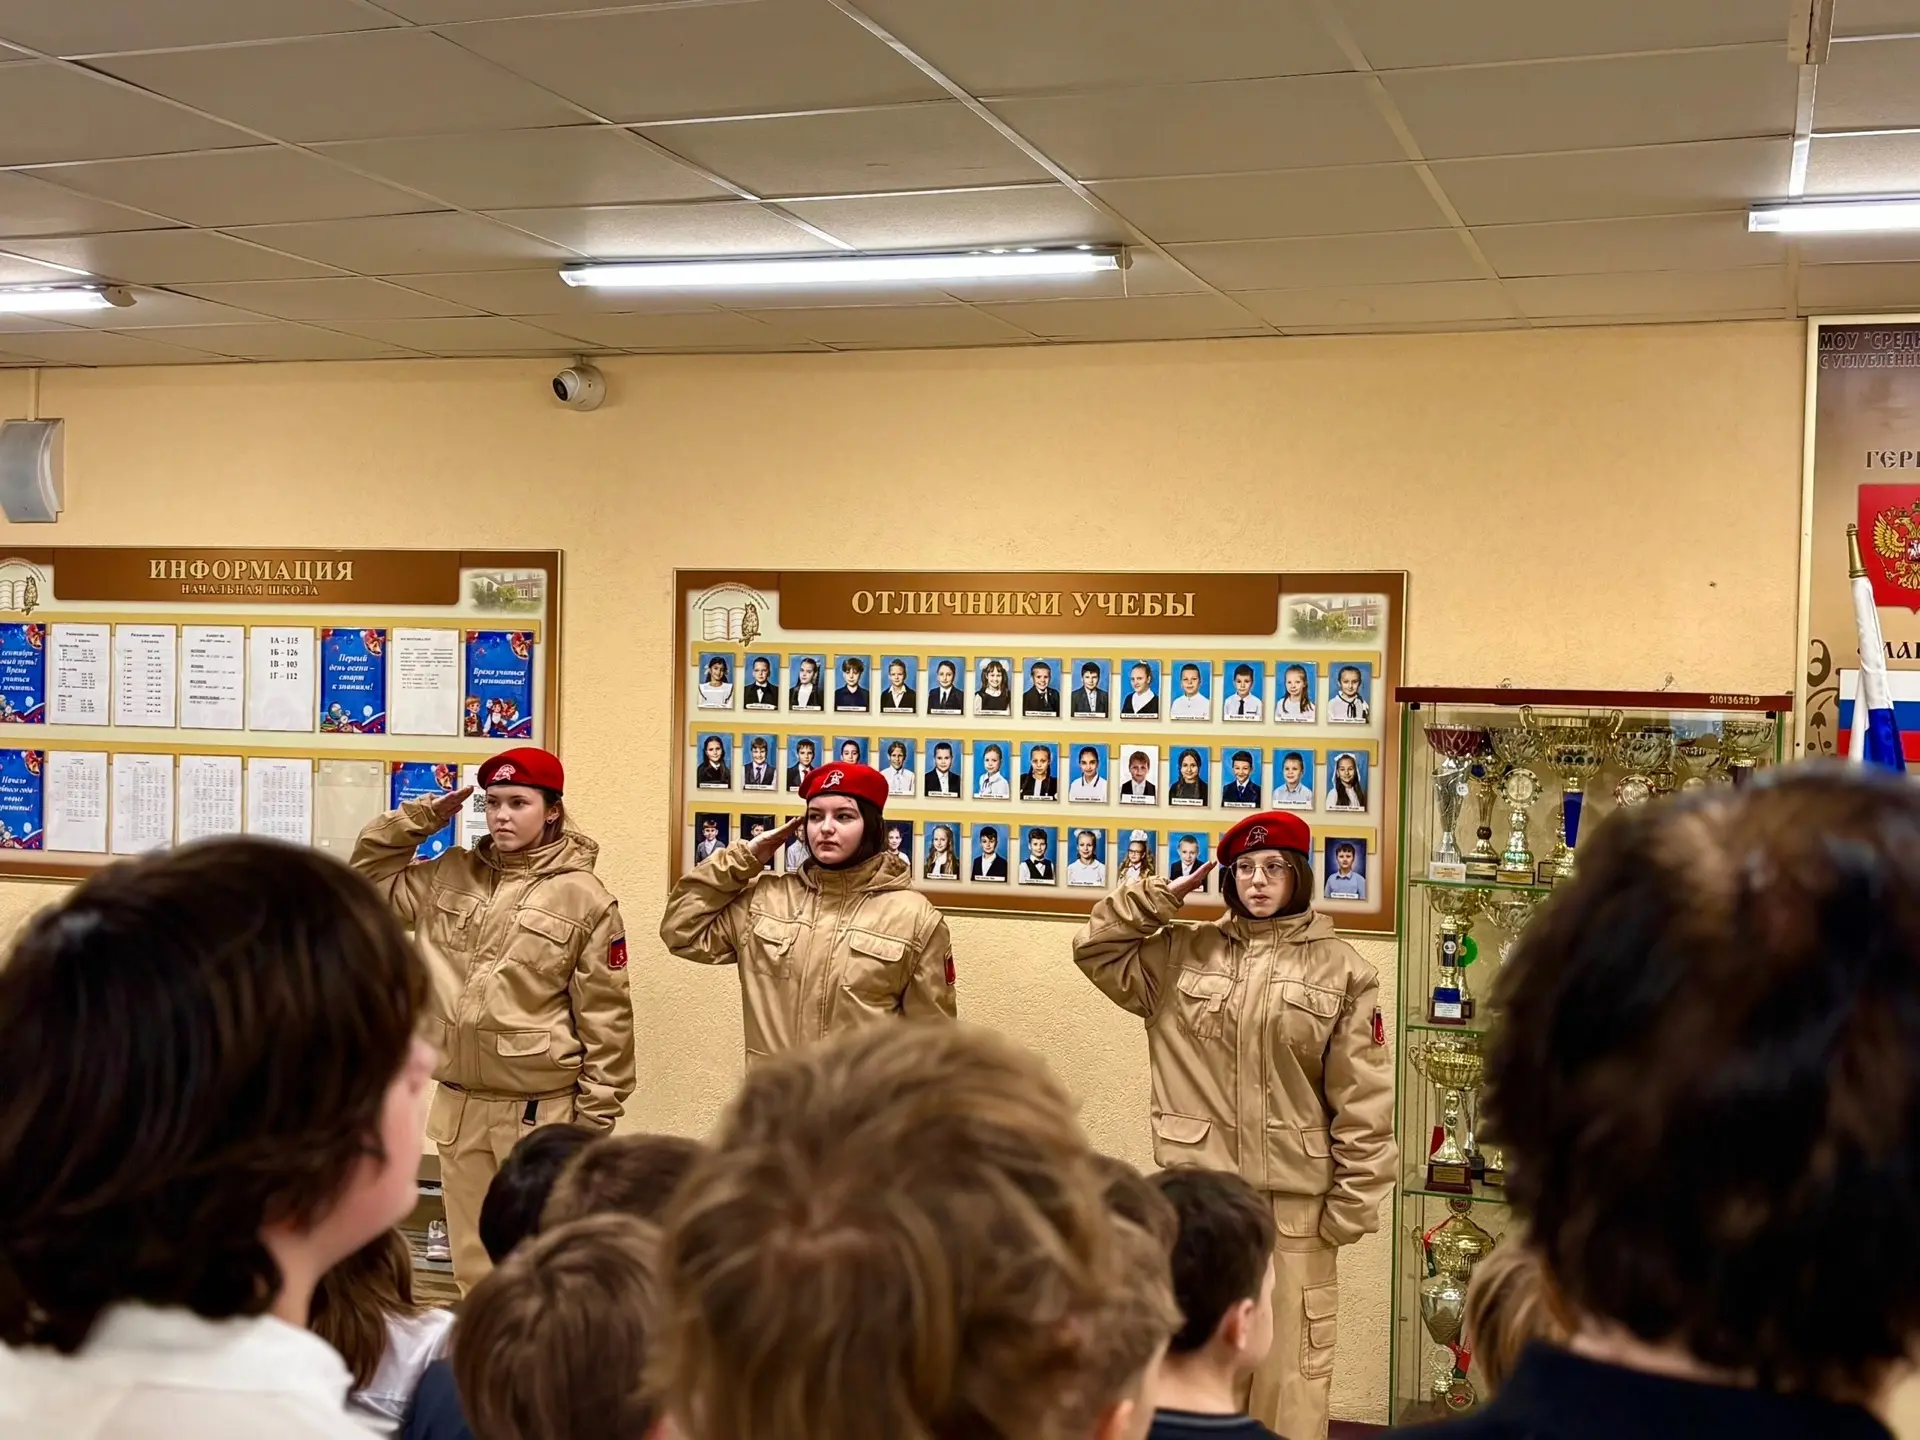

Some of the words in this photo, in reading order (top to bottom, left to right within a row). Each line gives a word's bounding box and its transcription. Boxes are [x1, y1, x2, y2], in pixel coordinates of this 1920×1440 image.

[1819, 332, 1859, 350] МОУ
[149, 559, 354, 585] ИНФОРМАЦИЯ
[181, 584, 262, 595] НАЧАЛЬНАЯ
[268, 585, 319, 596] ШКОЛА
[851, 591, 1062, 617] ОТЛИЧНИКИ
[1071, 592, 1195, 617] УЧЕБЫ
[339, 654, 367, 664] Первый
[1709, 695, 1760, 705] 2101362219
